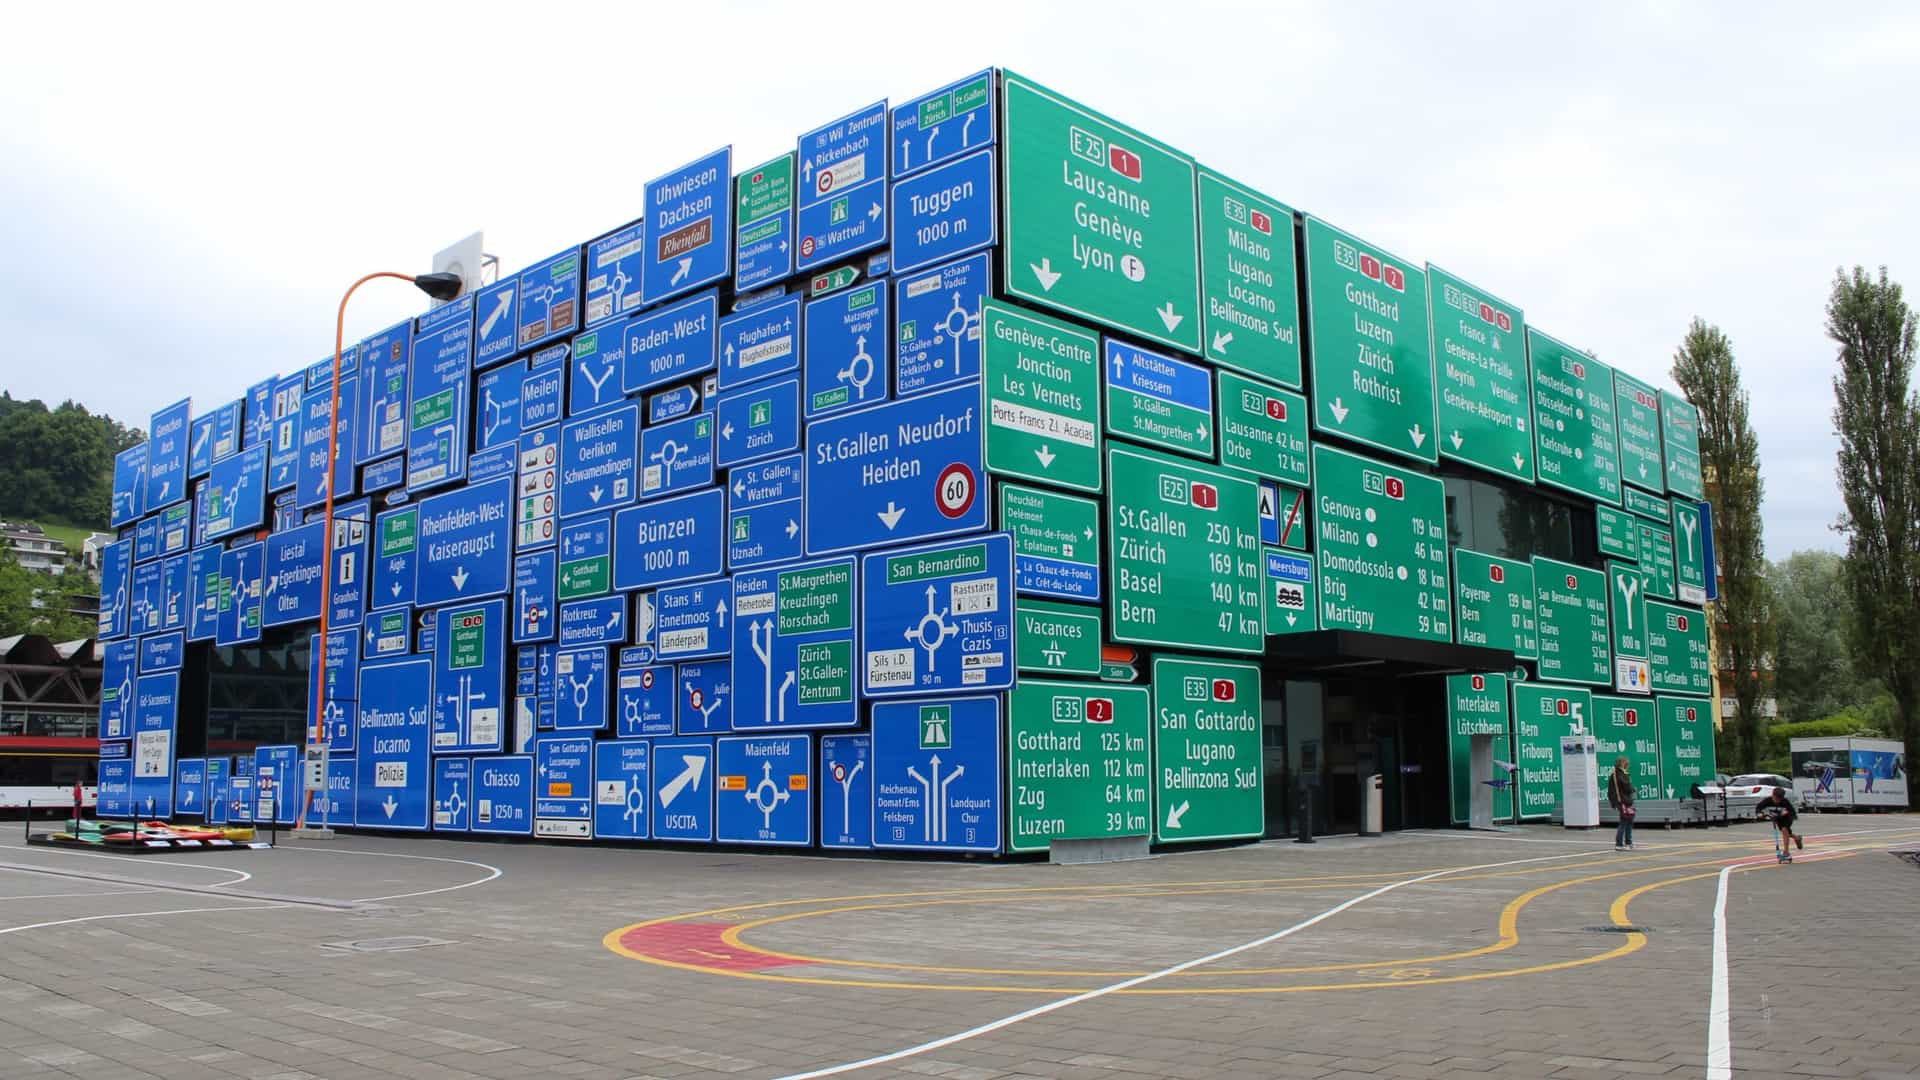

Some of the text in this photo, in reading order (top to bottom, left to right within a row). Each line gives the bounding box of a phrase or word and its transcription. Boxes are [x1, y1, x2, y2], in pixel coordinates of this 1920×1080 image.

[829, 112, 883, 143] Wil Zentrum
[816, 136, 869, 167] Rickenbach
[656, 168, 717, 205] Uhwiesen
[1064, 160, 1150, 217] Lausanne
[910, 181, 973, 217] Tuggen
[659, 195, 712, 229] Dachsen
[827, 220, 865, 245] Wattwil
[916, 217, 967, 246] 1000 m
[1075, 202, 1143, 248] Genève
[664, 224, 706, 255] Rheinfall
[1228, 229, 1270, 261] Milano
[1073, 235, 1137, 277] Lyon F
[943, 264, 970, 279] Schaan
[1228, 254, 1272, 287] Lugano
[944, 277, 967, 290] Vaduz
[1228, 280, 1275, 312] Locarno
[1345, 283, 1399, 321] Gotthard
[1211, 297, 1293, 345] Bellinzona Sud
[1355, 312, 1393, 345] Luzern
[632, 315, 706, 354] Baden-West
[739, 324, 781, 345] Flughafen
[995, 320, 1092, 364] Genève-Centre
[479, 335, 512, 357] AUSFAHRT
[650, 353, 685, 374] 1000 m
[1017, 352, 1072, 382] Jonction
[1132, 354, 1176, 377] Altstätten
[1358, 344, 1394, 375] Zürich
[524, 379, 558, 400] Meilen
[1004, 375, 1082, 410] Les Vernets
[1132, 373, 1172, 395] Kriessern
[1353, 371, 1401, 404] Rothrist
[526, 403, 555, 418] 1000 m
[1133, 396, 1171, 416] St.Gallen
[575, 419, 623, 442] Wallisellen
[993, 405, 1015, 423] Ports
[1019, 412, 1045, 430] Francs
[1064, 423, 1093, 441] Acacias
[1134, 416, 1193, 442] St.Margrethen
[746, 430, 773, 448] Zürich
[817, 408, 972, 465] St.Gallen Neudorf
[579, 441, 617, 461] Oerlikon
[564, 458, 632, 484] Schwamendingen
[747, 464, 791, 484] St. Gallen
[863, 459, 920, 486] Heiden
[747, 484, 783, 502] Wattwil
[947, 480, 964, 500] 60
[423, 501, 504, 536] Rheinfelden-West
[1321, 496, 1361, 521] Genova
[639, 517, 695, 544] Bünzen
[1119, 506, 1256, 550] St.Gallen 250 km
[1322, 522, 1359, 546] Milano
[281, 540, 306, 561] Liestal
[428, 531, 495, 562] Kaiseraugst
[732, 544, 763, 560] Uznach
[1120, 537, 1257, 577] Zürich 169 km
[643, 549, 689, 571] 1000 m
[893, 554, 980, 578] San Bernardino
[1269, 559, 1309, 578] Meersburg
[1323, 550, 1394, 580] Domodossola
[279, 561, 321, 585] Egerkingen
[780, 571, 848, 590] St.Margrethen
[1024, 562, 1092, 580] La Chaux-de-Fonds
[736, 578, 768, 592] Heiden
[1120, 569, 1258, 607] Basel 140 km
[1325, 577, 1346, 601] Brig
[1461, 584, 1490, 603] Payerne
[278, 594, 299, 611] Olten
[664, 594, 689, 608] Stans
[738, 593, 774, 610] Rehetobel
[780, 591, 838, 611] Kreuzlingen
[563, 608, 597, 621] Rotkreuz
[659, 610, 710, 627] Ennetmoos
[780, 612, 830, 630] Rorschach
[1121, 600, 1259, 635] Bern 47 km
[1325, 603, 1374, 630] Martigny
[562, 626, 605, 640] Hünenberg
[961, 619, 992, 635] Thusis
[1025, 617, 1082, 638] Vacances
[661, 630, 705, 647] Länderpark
[961, 638, 991, 651] Cazis
[623, 652, 648, 663] Guarda
[800, 647, 831, 663] Zürich
[874, 654, 907, 668] Sils i.D.
[681, 668, 701, 678] Arosa
[800, 664, 848, 681] St.Gallen-
[871, 668, 911, 682] Fürstenau
[800, 685, 841, 699] Zentrum
[1457, 696, 1500, 713] Interlaken
[361, 704, 426, 728] Bellinzona Sud
[1161, 708, 1255, 731] San Gottardo
[1571, 703, 1584, 735] 5
[374, 736, 410, 753] Locarno
[745, 742, 790, 757] Maienfeld
[1018, 731, 1144, 751] Gotthard 125 km
[1186, 739, 1235, 765] Lugano
[1522, 744, 1552, 762] Fribourg
[378, 766, 404, 782] Polizia
[483, 770, 519, 787] Chiasso
[1018, 760, 1144, 779] Interlaken 112 km
[1165, 768, 1256, 789] Bellinzona Sud
[880, 784, 917, 795] Reichenau
[1018, 786, 1144, 810] Zug 64 km
[1525, 791, 1554, 806] Yverdon
[495, 804, 523, 819] 1250 m
[878, 797, 919, 809] Domat/Ems
[950, 798, 991, 810] Landquart
[666, 815, 697, 830] USCITA
[883, 811, 914, 825] Felsberg
[961, 812, 980, 824] Chur
[1018, 813, 1145, 835] Luzern 39 km
